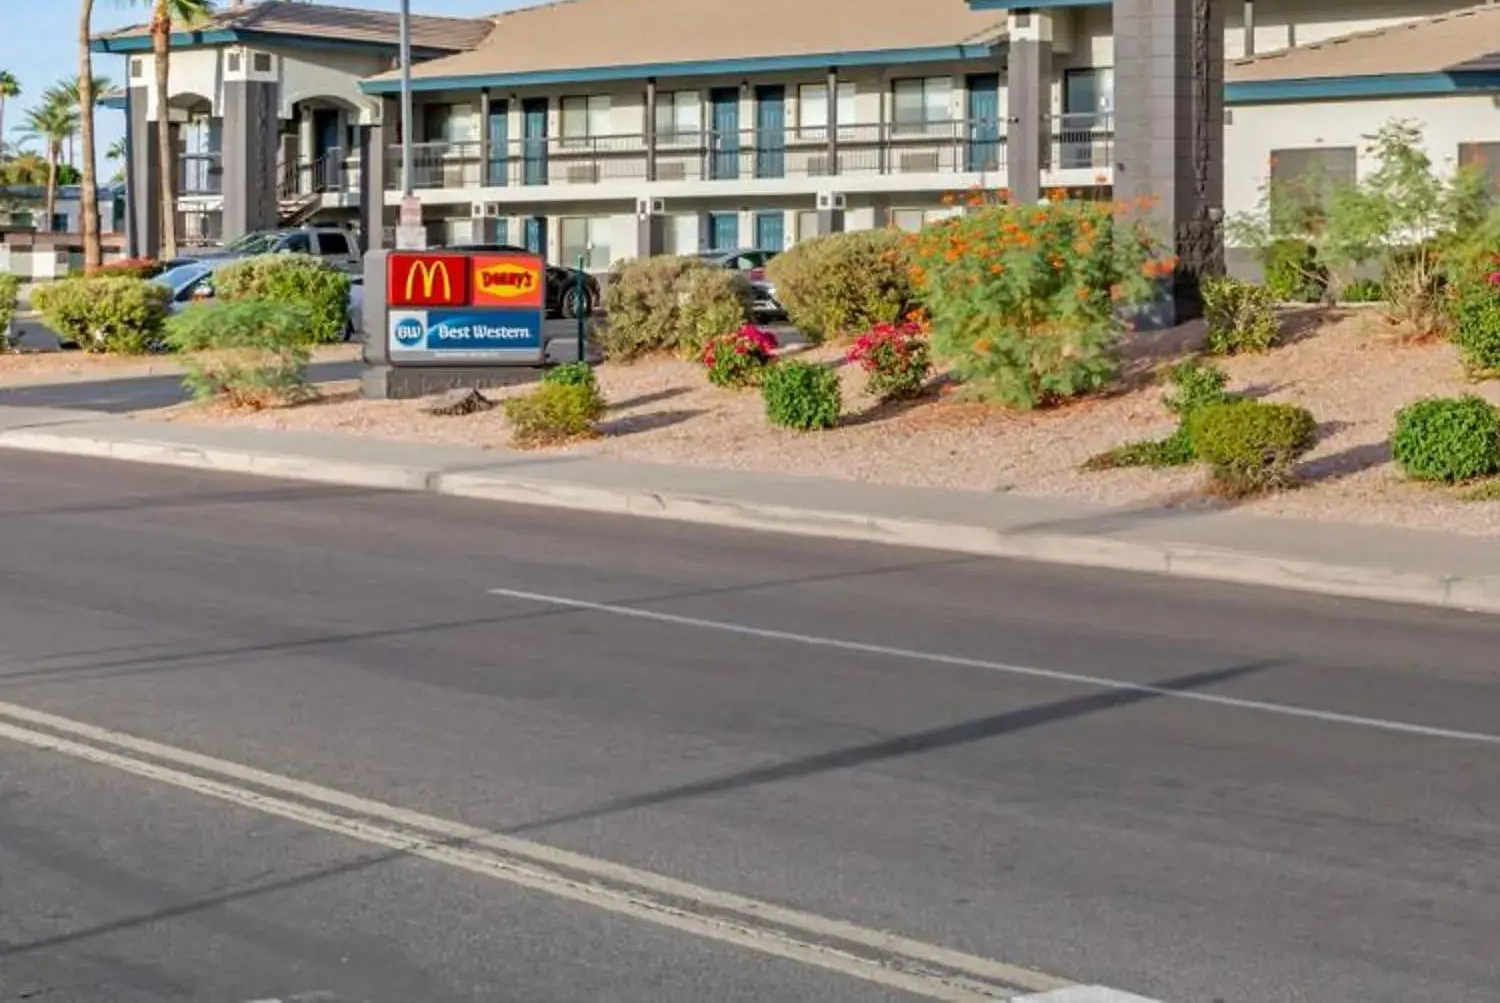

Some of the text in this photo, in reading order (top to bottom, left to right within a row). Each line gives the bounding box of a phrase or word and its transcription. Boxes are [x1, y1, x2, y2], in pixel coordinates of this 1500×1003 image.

[397, 325, 420, 338] BW
[439, 324, 530, 339] Best Western
